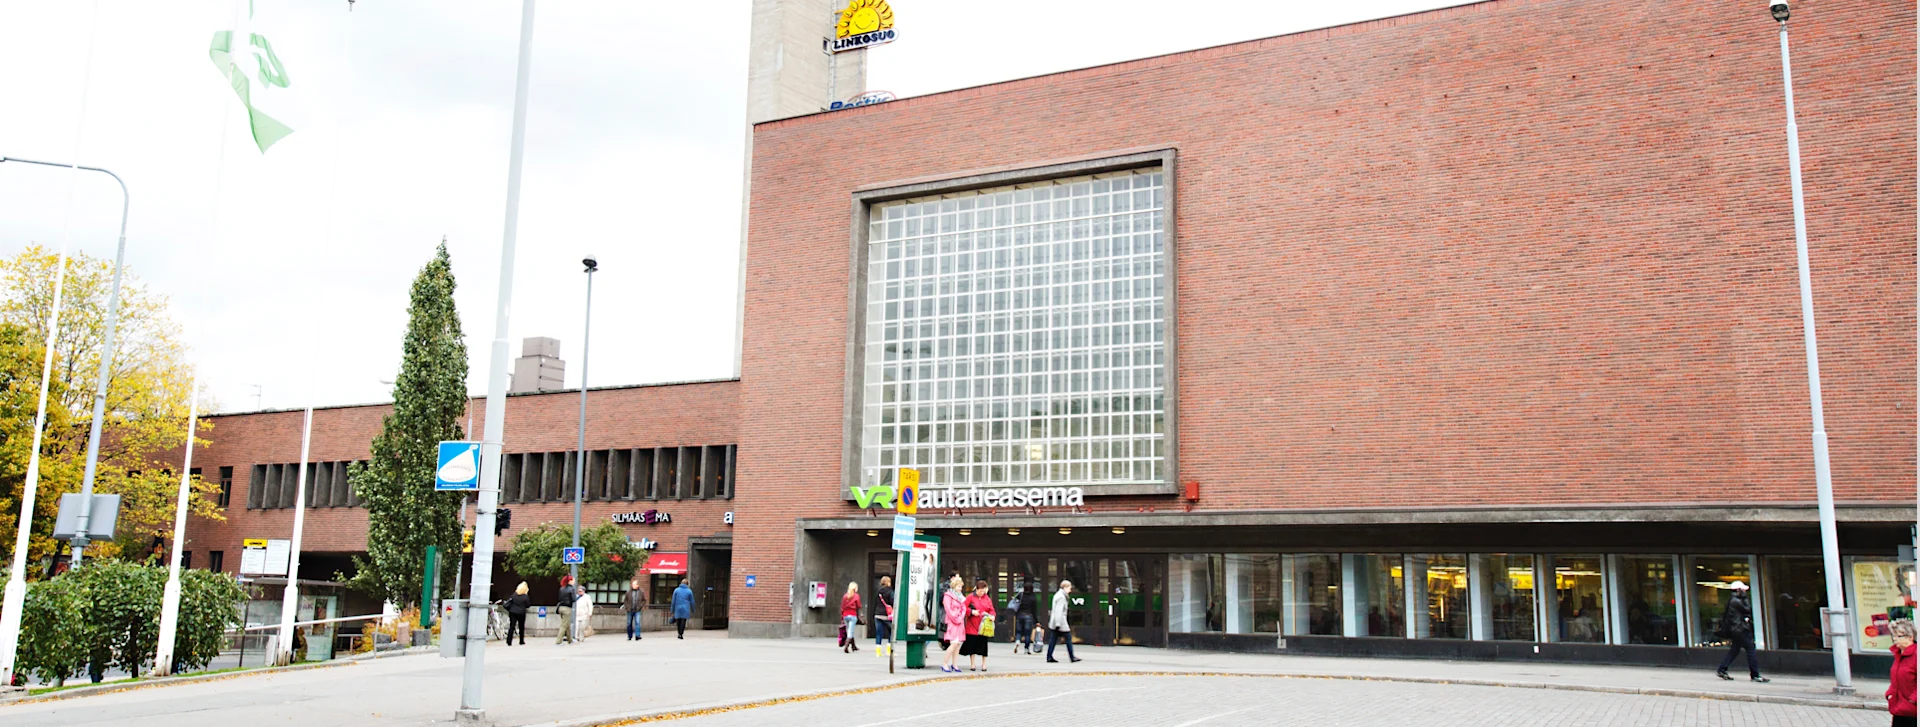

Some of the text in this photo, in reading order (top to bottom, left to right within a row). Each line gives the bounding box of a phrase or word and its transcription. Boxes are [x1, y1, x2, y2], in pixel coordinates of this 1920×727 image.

[833, 29, 896, 50] LINKOSUO
[902, 471, 917, 482] TAKSI
[850, 484, 1083, 509] VR autatieasema
[1072, 597, 1085, 606] VR
